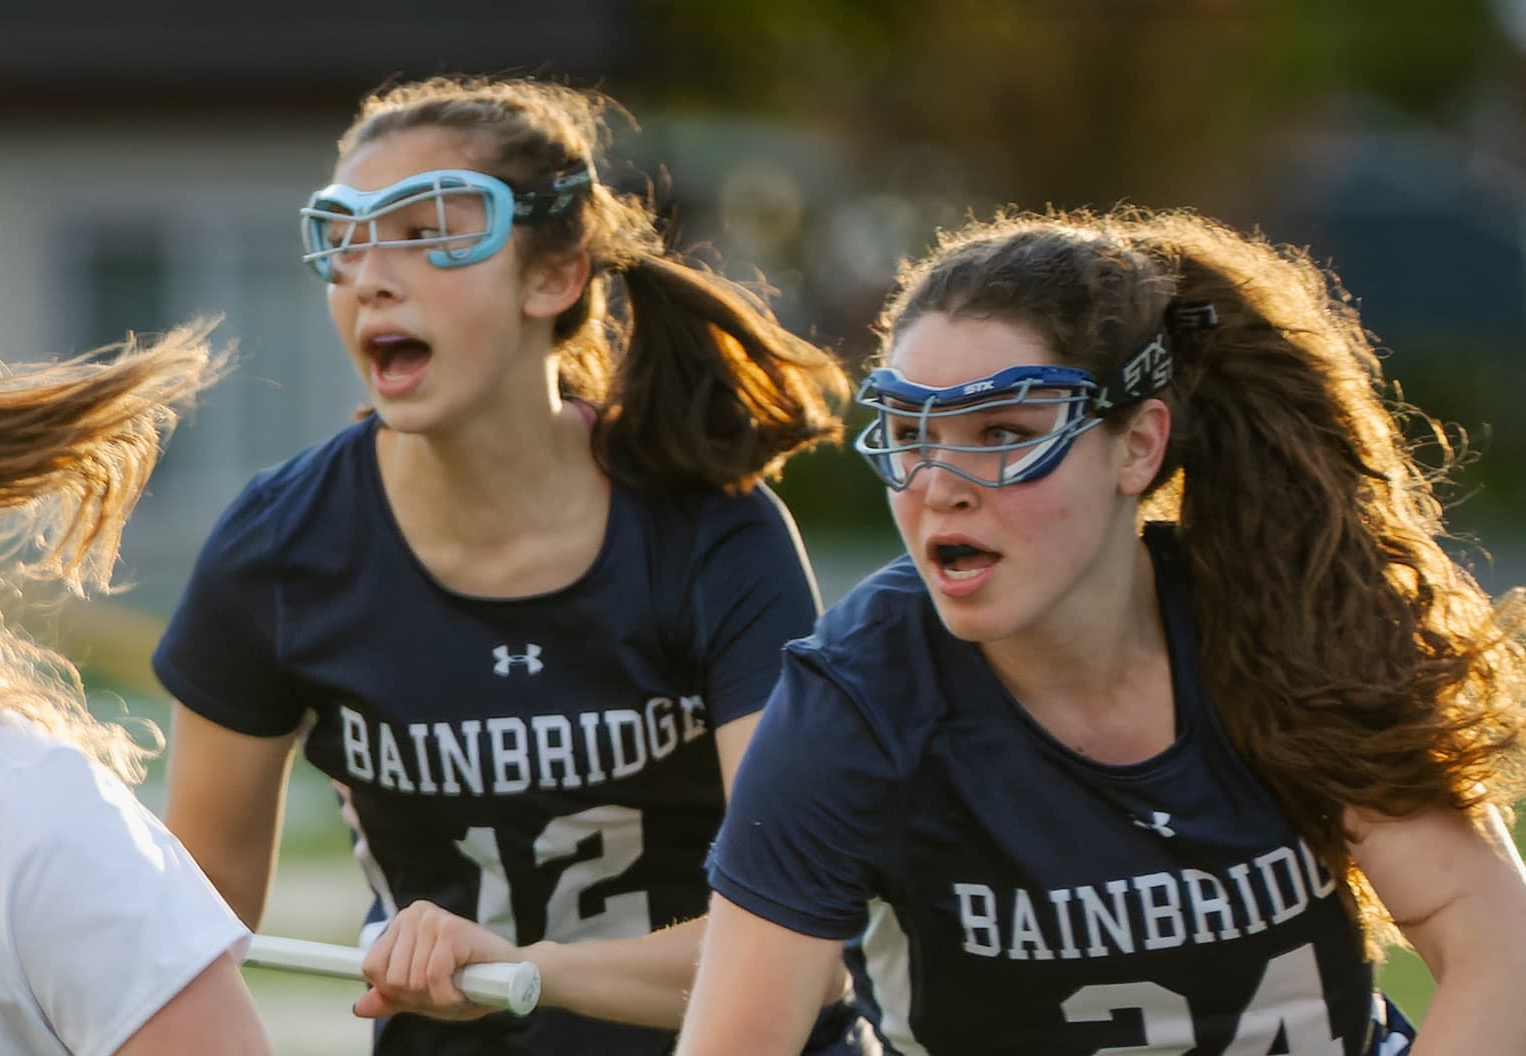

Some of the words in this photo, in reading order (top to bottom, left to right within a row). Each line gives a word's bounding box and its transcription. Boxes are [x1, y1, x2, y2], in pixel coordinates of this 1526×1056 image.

[962, 379, 995, 396] STX
[1123, 333, 1167, 391] STX
[340, 695, 707, 797] BAINBRIDGE
[454, 804, 652, 947] 12
[952, 836, 1337, 961] BAINBRID
